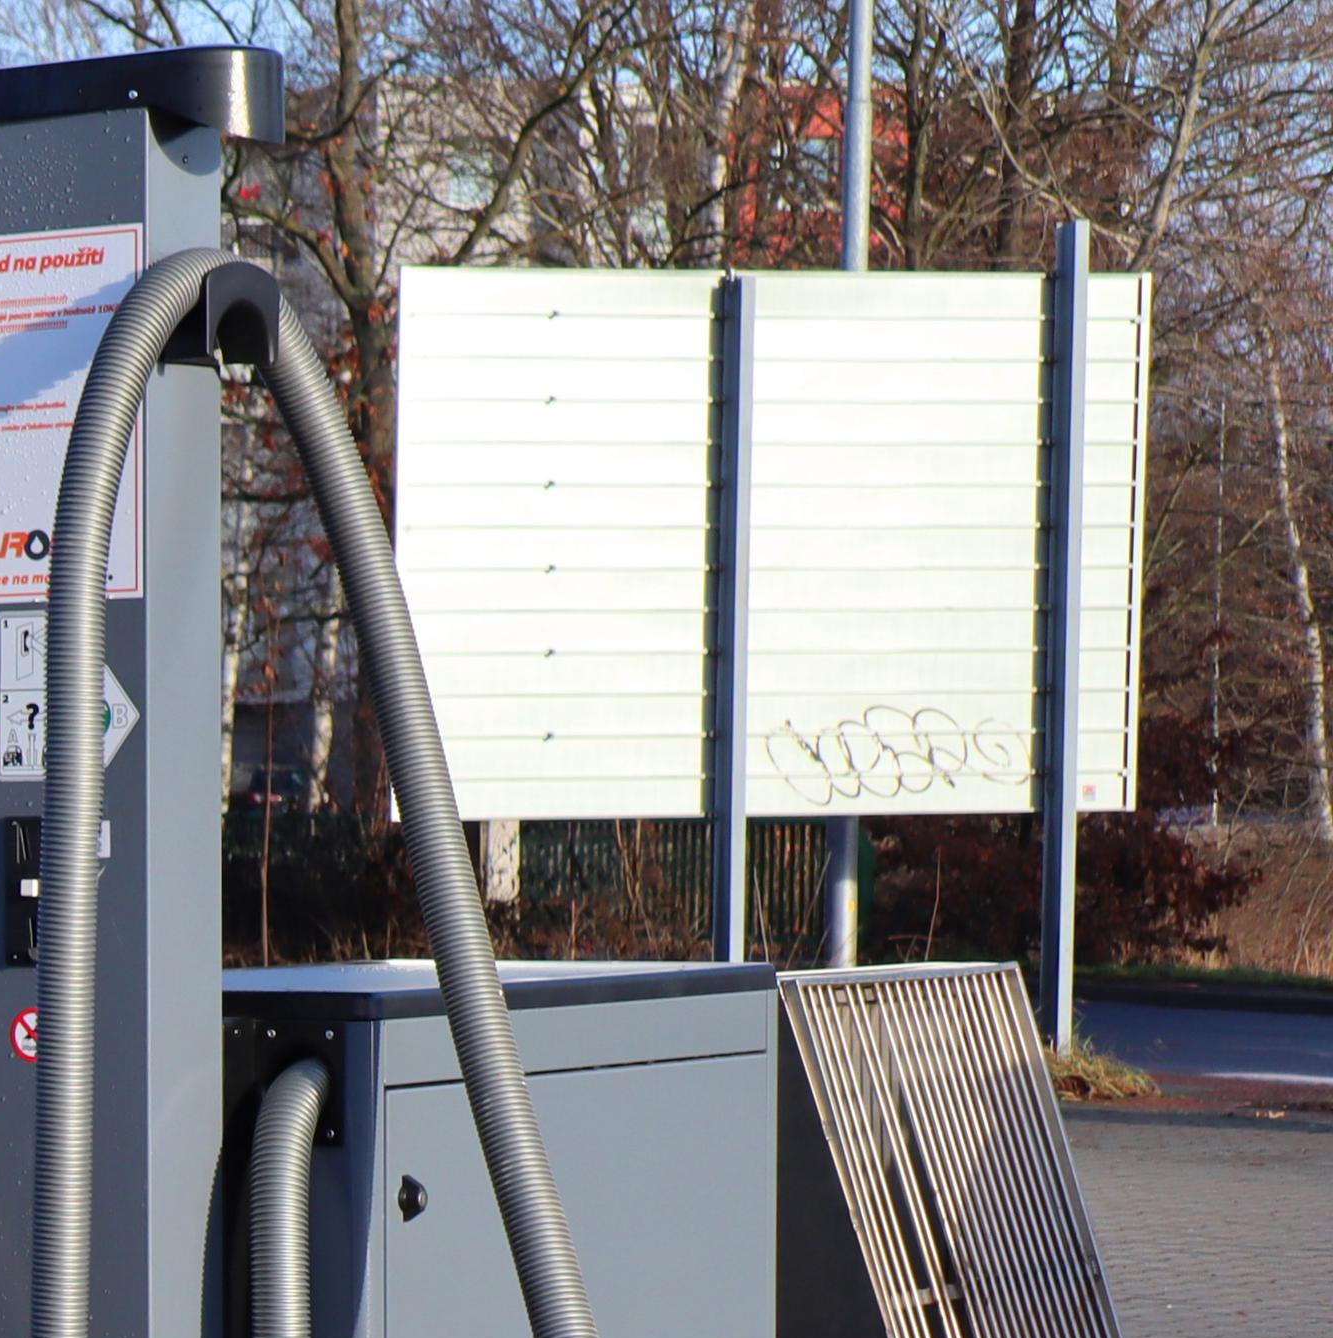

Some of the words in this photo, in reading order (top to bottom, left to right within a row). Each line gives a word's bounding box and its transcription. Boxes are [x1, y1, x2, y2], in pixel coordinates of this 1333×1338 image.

[13, 257, 36, 271] na
[38, 247, 105, 274] použití
[12, 575, 29, 586] na
[2, 619, 9, 629] 1
[2, 694, 9, 704] 2
[111, 703, 129, 730] B
